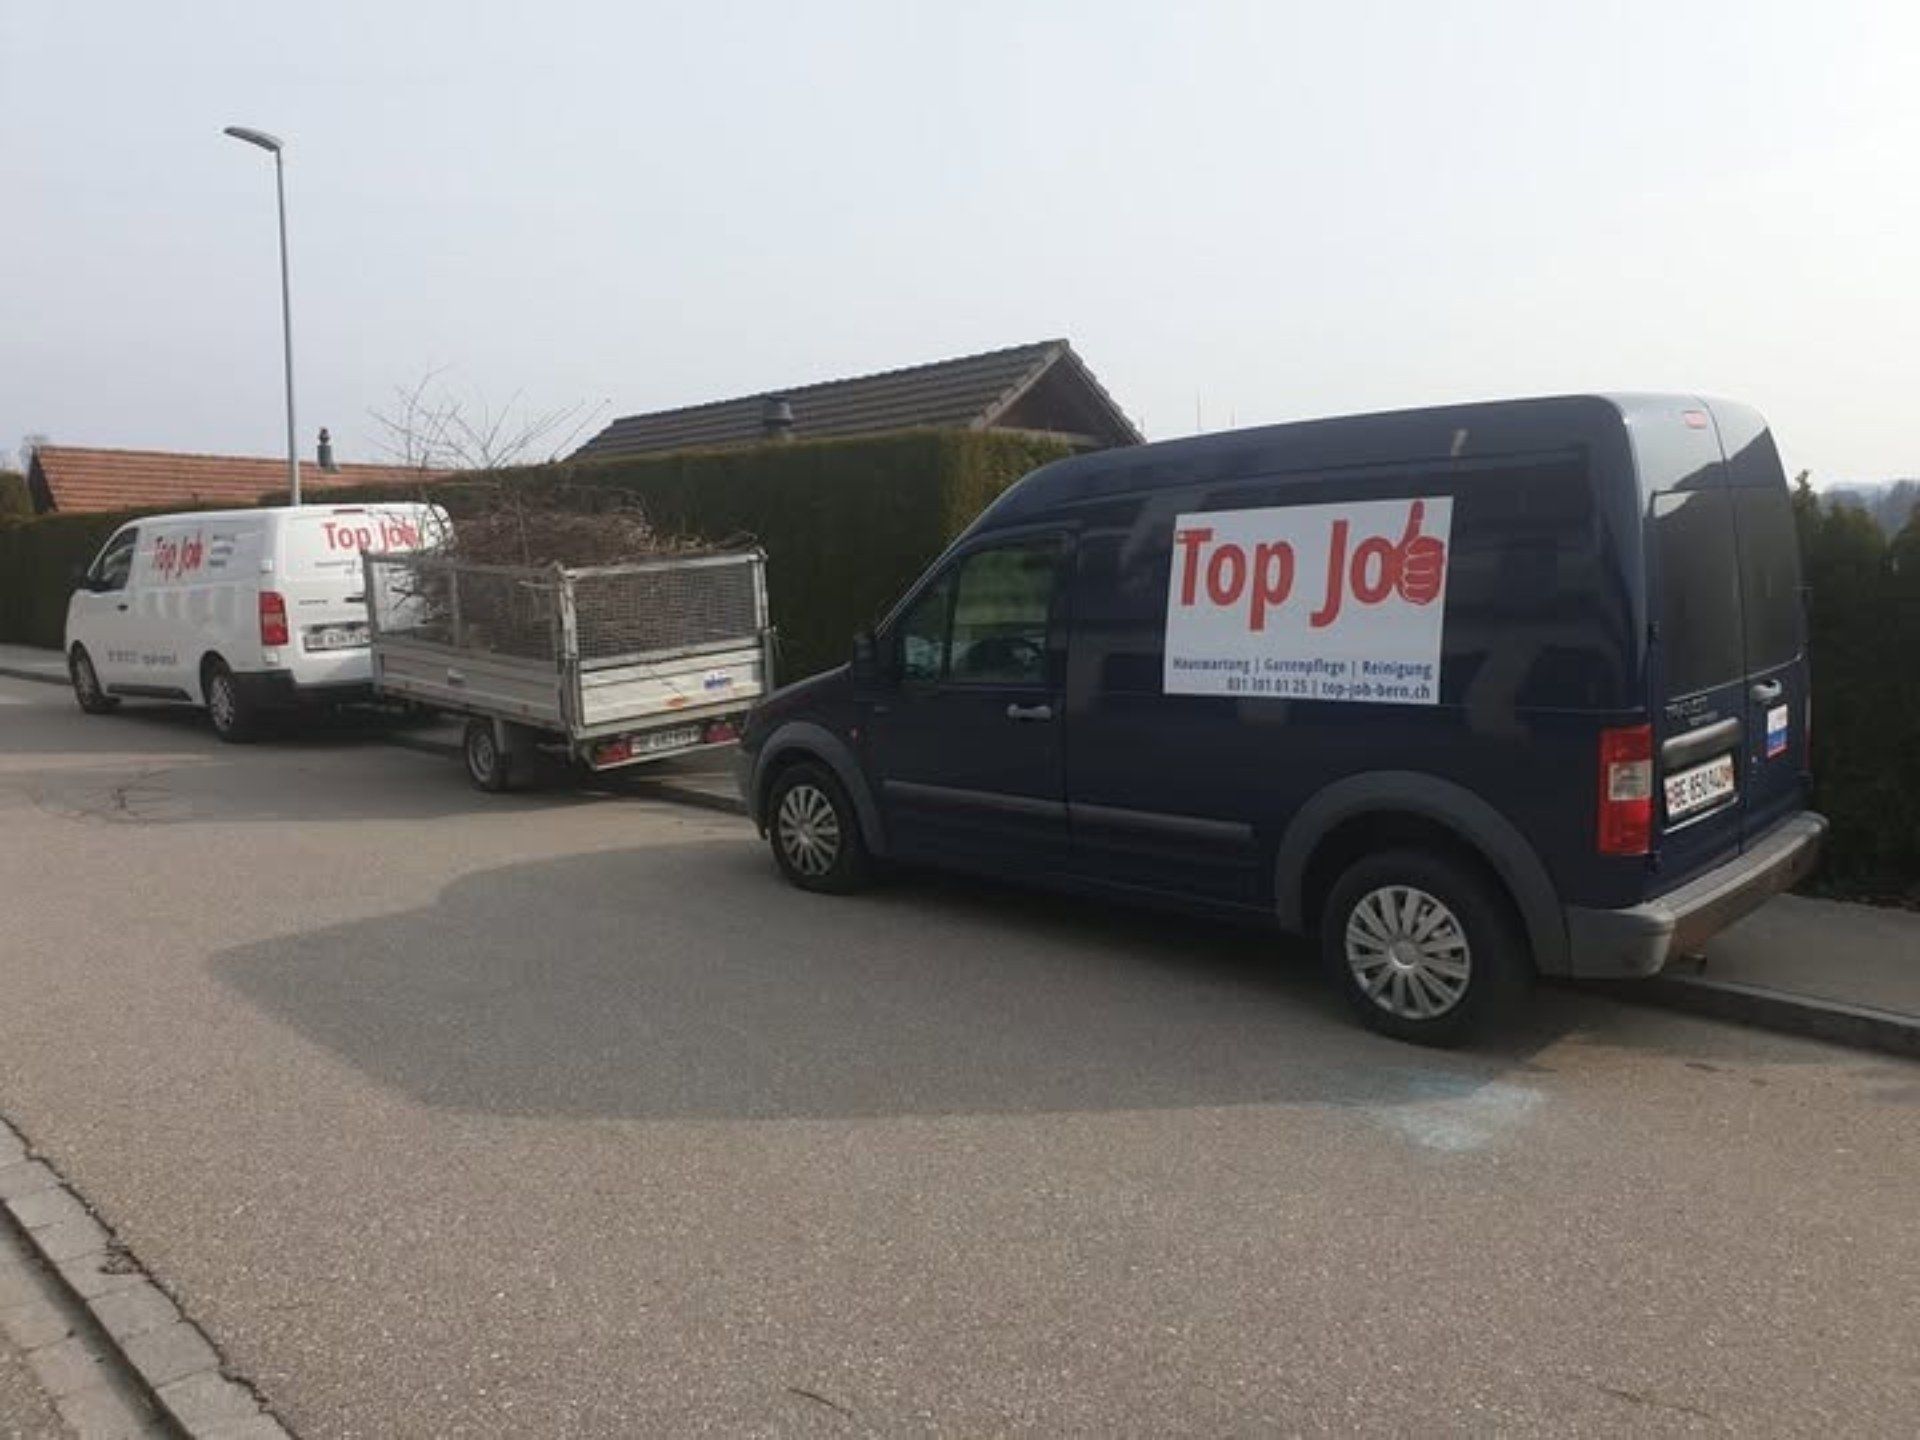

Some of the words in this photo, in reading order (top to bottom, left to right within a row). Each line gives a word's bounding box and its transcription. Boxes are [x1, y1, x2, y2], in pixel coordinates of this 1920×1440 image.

[321, 522, 371, 551] Top
[1175, 527, 1295, 632] Top
[1362, 660, 1433, 681] Reinigung
[1321, 680, 1431, 700] top-job-bern.ch
